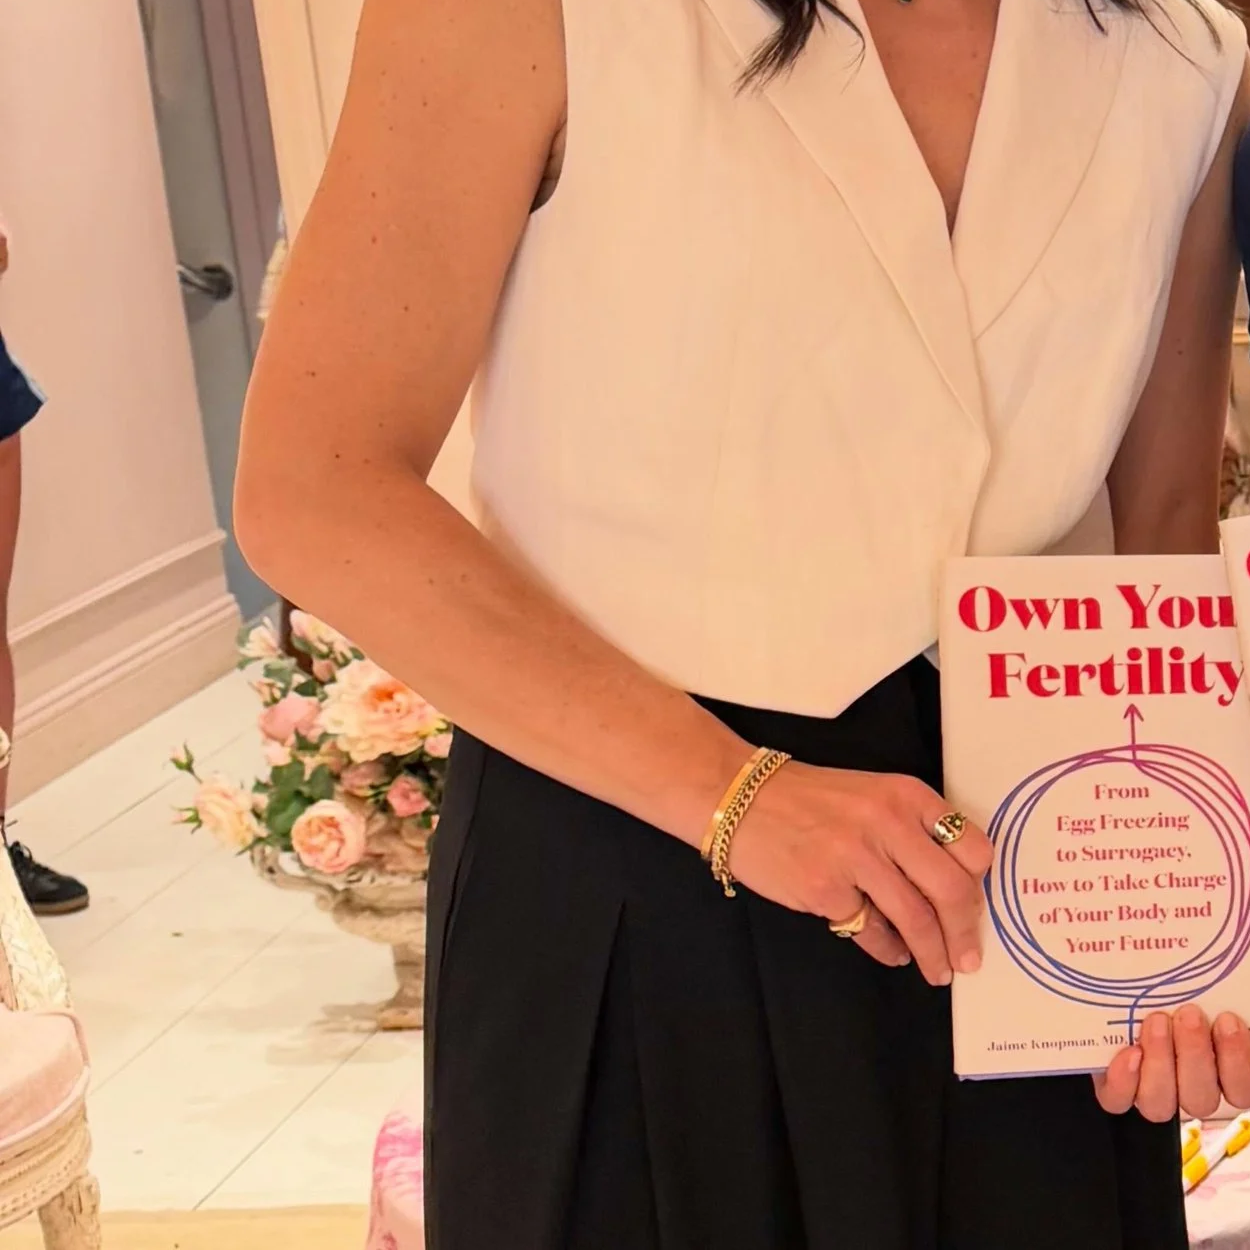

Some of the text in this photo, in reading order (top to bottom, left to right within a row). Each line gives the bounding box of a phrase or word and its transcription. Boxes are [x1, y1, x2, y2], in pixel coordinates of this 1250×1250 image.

[958, 584, 1238, 632] Own You
[988, 647, 1245, 706] Fertility
[1094, 783, 1150, 800] From
[1057, 812, 1190, 836] Egg Freezing
[1057, 845, 1192, 862] to Surrogacy,
[1022, 872, 1227, 894] How to Take Charge
[1039, 901, 1212, 924] of Your Body and
[1066, 935, 1189, 954] Your Future
[987, 1040, 1027, 1052] Jaime
